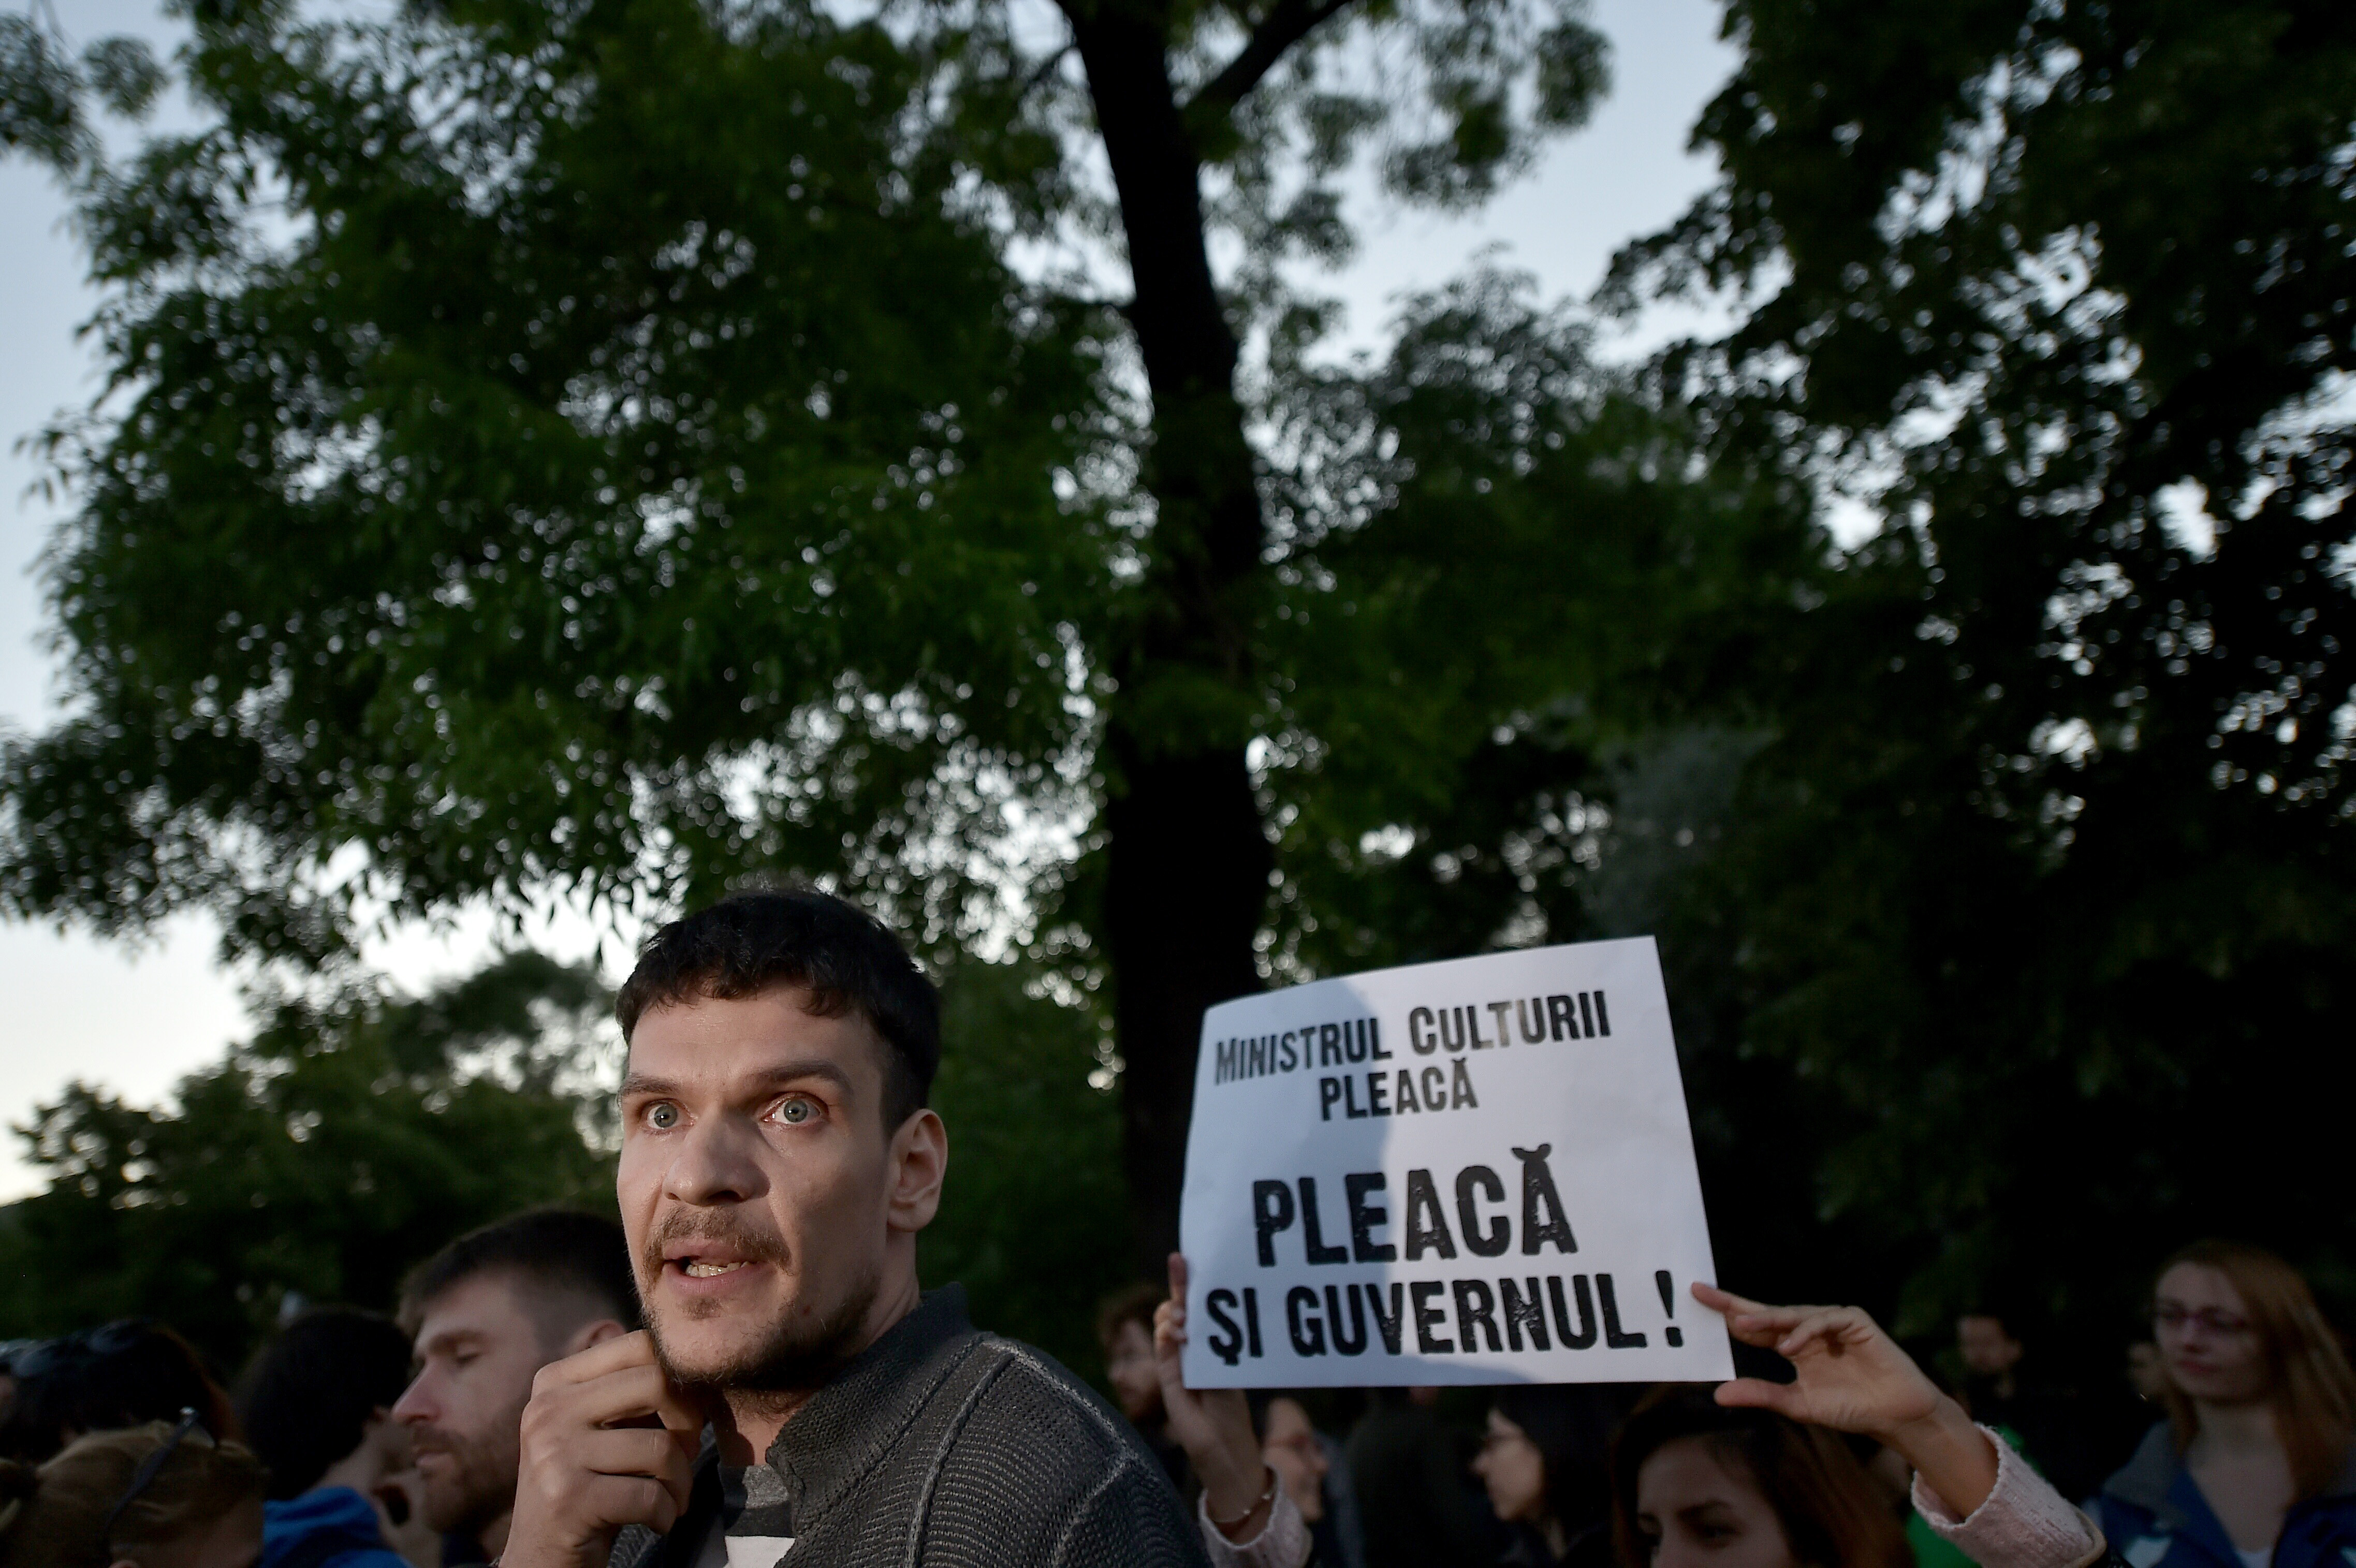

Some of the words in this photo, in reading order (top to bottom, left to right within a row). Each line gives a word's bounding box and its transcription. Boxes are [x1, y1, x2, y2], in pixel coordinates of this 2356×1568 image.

[1214, 1017, 1393, 1086] MINISTRUL
[1408, 989, 1612, 1056] CULTURII
[1319, 1057, 1480, 1122] PLEACĂ
[1251, 1142, 1579, 1268] PLEACĂ
